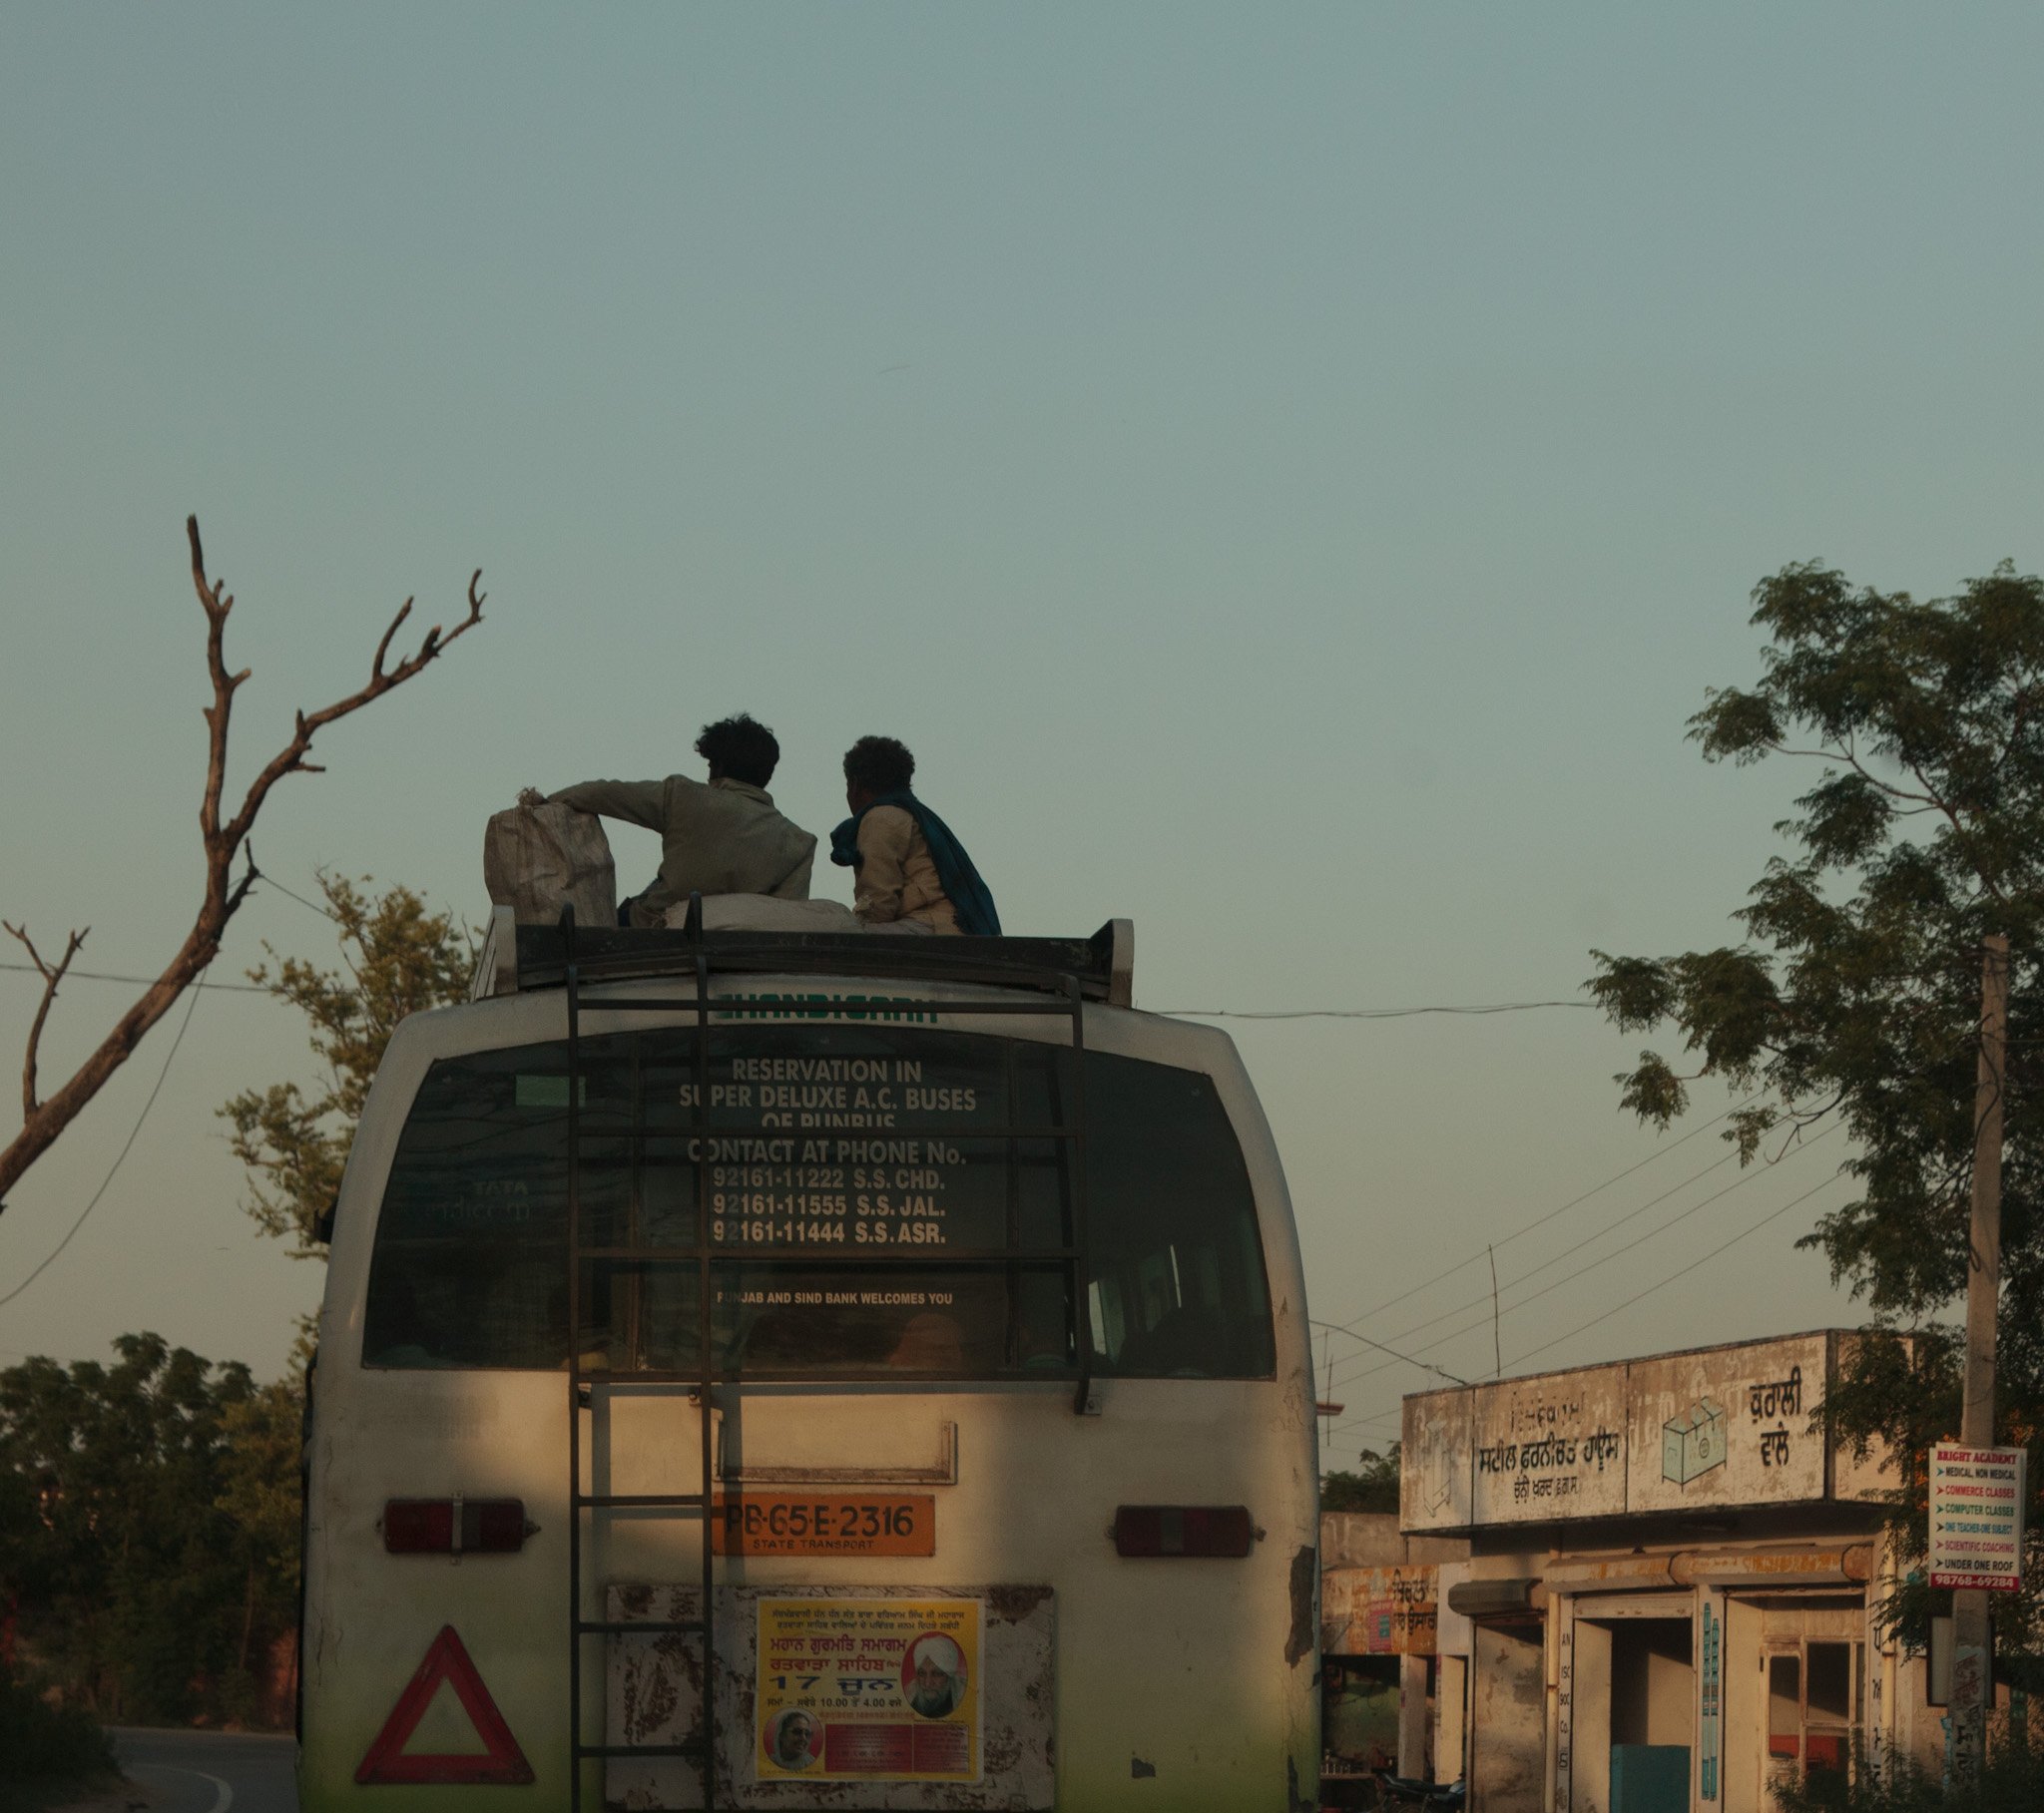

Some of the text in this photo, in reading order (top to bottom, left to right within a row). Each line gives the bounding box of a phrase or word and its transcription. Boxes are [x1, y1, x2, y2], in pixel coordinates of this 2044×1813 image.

[733, 1059, 922, 1083] RESERVATION IN
[760, 1086, 846, 1109] DELUXE
[853, 1088, 897, 1110] A.C.
[906, 1088, 976, 1111] BUSES
[688, 1138, 966, 1165] CONTACT AT PHONE No.
[714, 1166, 844, 1188] 92161-11222
[895, 1169, 945, 1190] CHD.
[714, 1193, 846, 1215] 92161-11555
[899, 1195, 945, 1216] JAL.
[714, 1220, 844, 1242] 92161-11444
[766, 1292, 791, 1304] AND
[794, 1292, 822, 1304] SIND
[825, 1292, 858, 1304] BANK
[860, 1292, 925, 1305] WELCOMES
[929, 1293, 953, 1305] YOU
[1937, 1451, 2017, 1465] BRIGHT ACADEMY
[1975, 1469, 1988, 1479] NON
[1990, 1469, 2016, 1480] MEDICAL
[1945, 1485, 2015, 1499] COMMERCE CLASSES
[1945, 1504, 2014, 1517] COMPUTER CLASSES
[754, 1540, 875, 1550] STATE TRANSPORT
[1944, 1541, 2014, 1554] SCIENTIFIC COACHING
[1944, 1559, 2014, 1572] UNDER ONE ROOF
[1934, 1575, 2014, 1587] 98768-69284
[770, 1633, 907, 1655] ਮਹਾਨ ਗੁਰਮਤਿ ਸਮਾਗਮ
[770, 1658, 830, 1672] ਰਤਵਾੜਾ
[837, 1654, 885, 1672] ਸਾਹਿਬ
[768, 1676, 897, 1696] 17 ਜੂਨ
[821, 1698, 847, 1707] 10.00
[863, 1698, 885, 1707] 4.00
